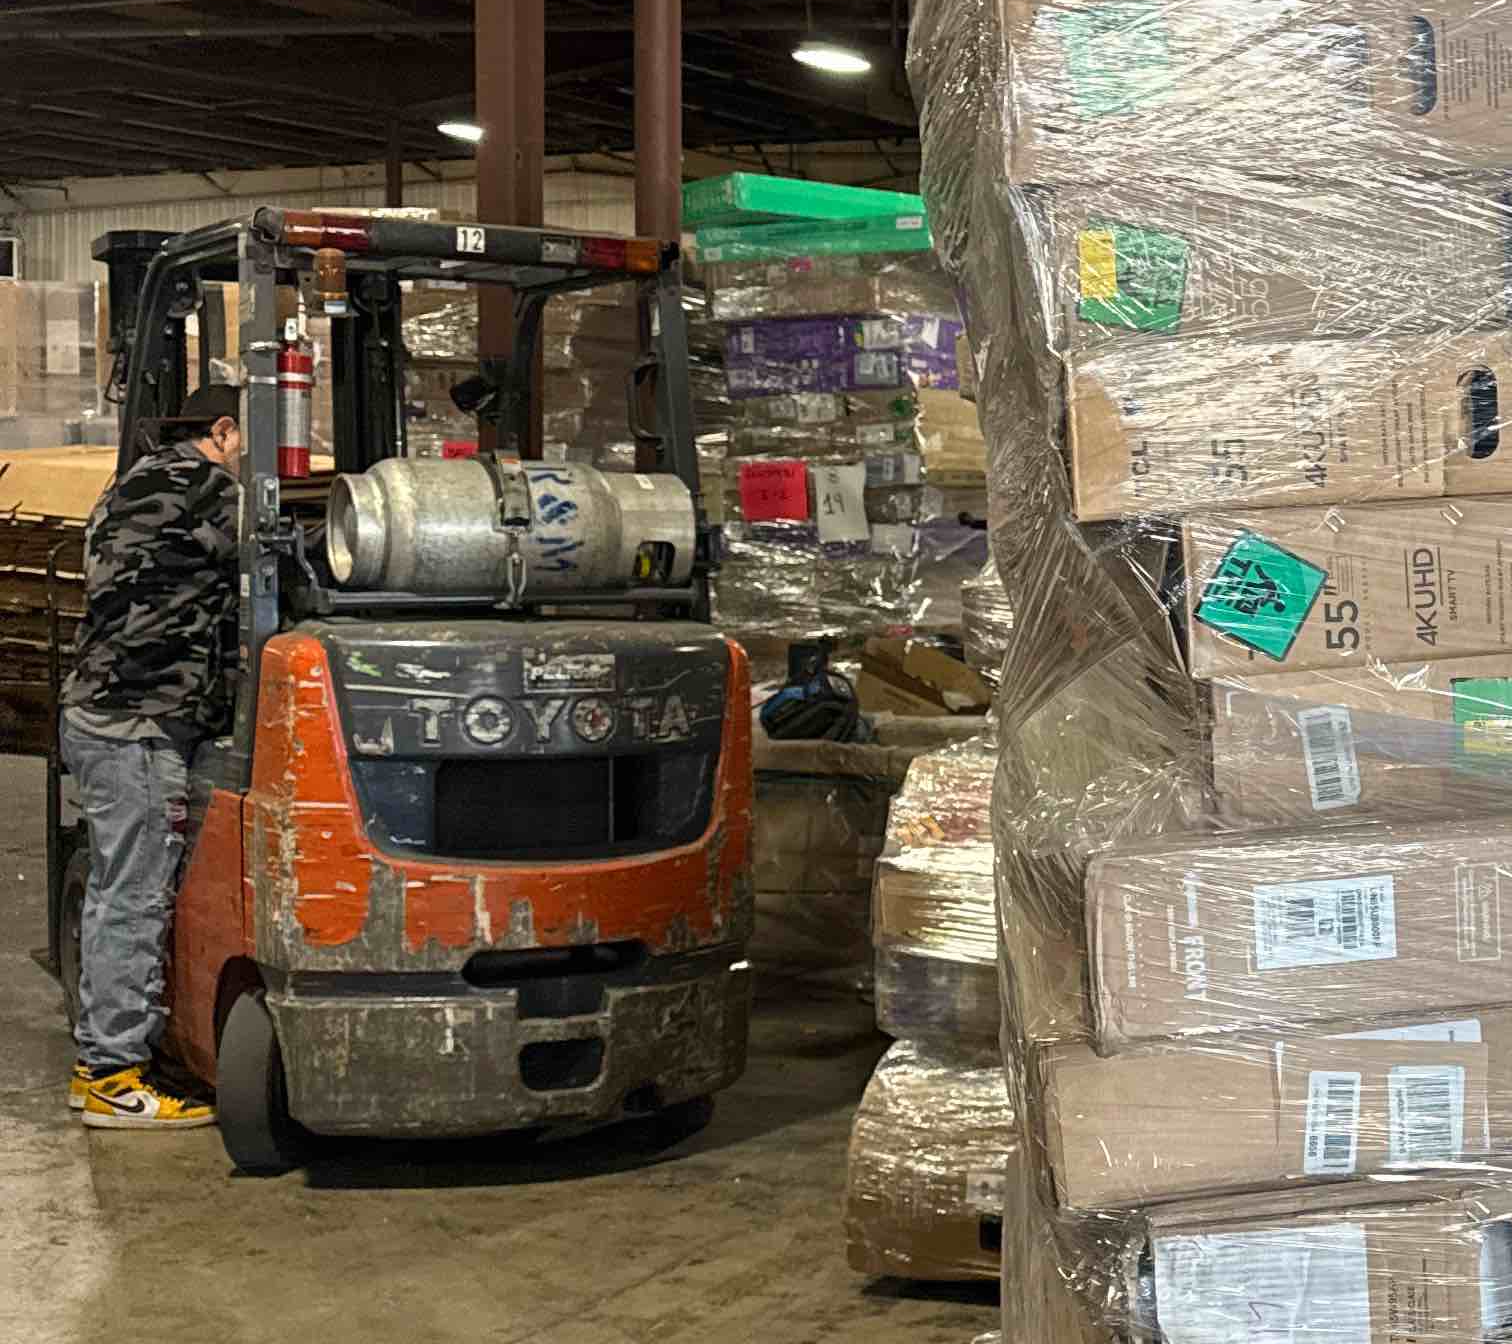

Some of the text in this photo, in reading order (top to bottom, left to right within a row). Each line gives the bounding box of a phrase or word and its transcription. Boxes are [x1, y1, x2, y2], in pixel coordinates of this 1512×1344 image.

[461, 229, 482, 251] 12
[1413, 548, 1438, 646] 4KUHD
[1448, 570, 1457, 621] SMART TV
[407, 693, 690, 746] TOYOTA
[1184, 936, 1207, 1001] FRONT
